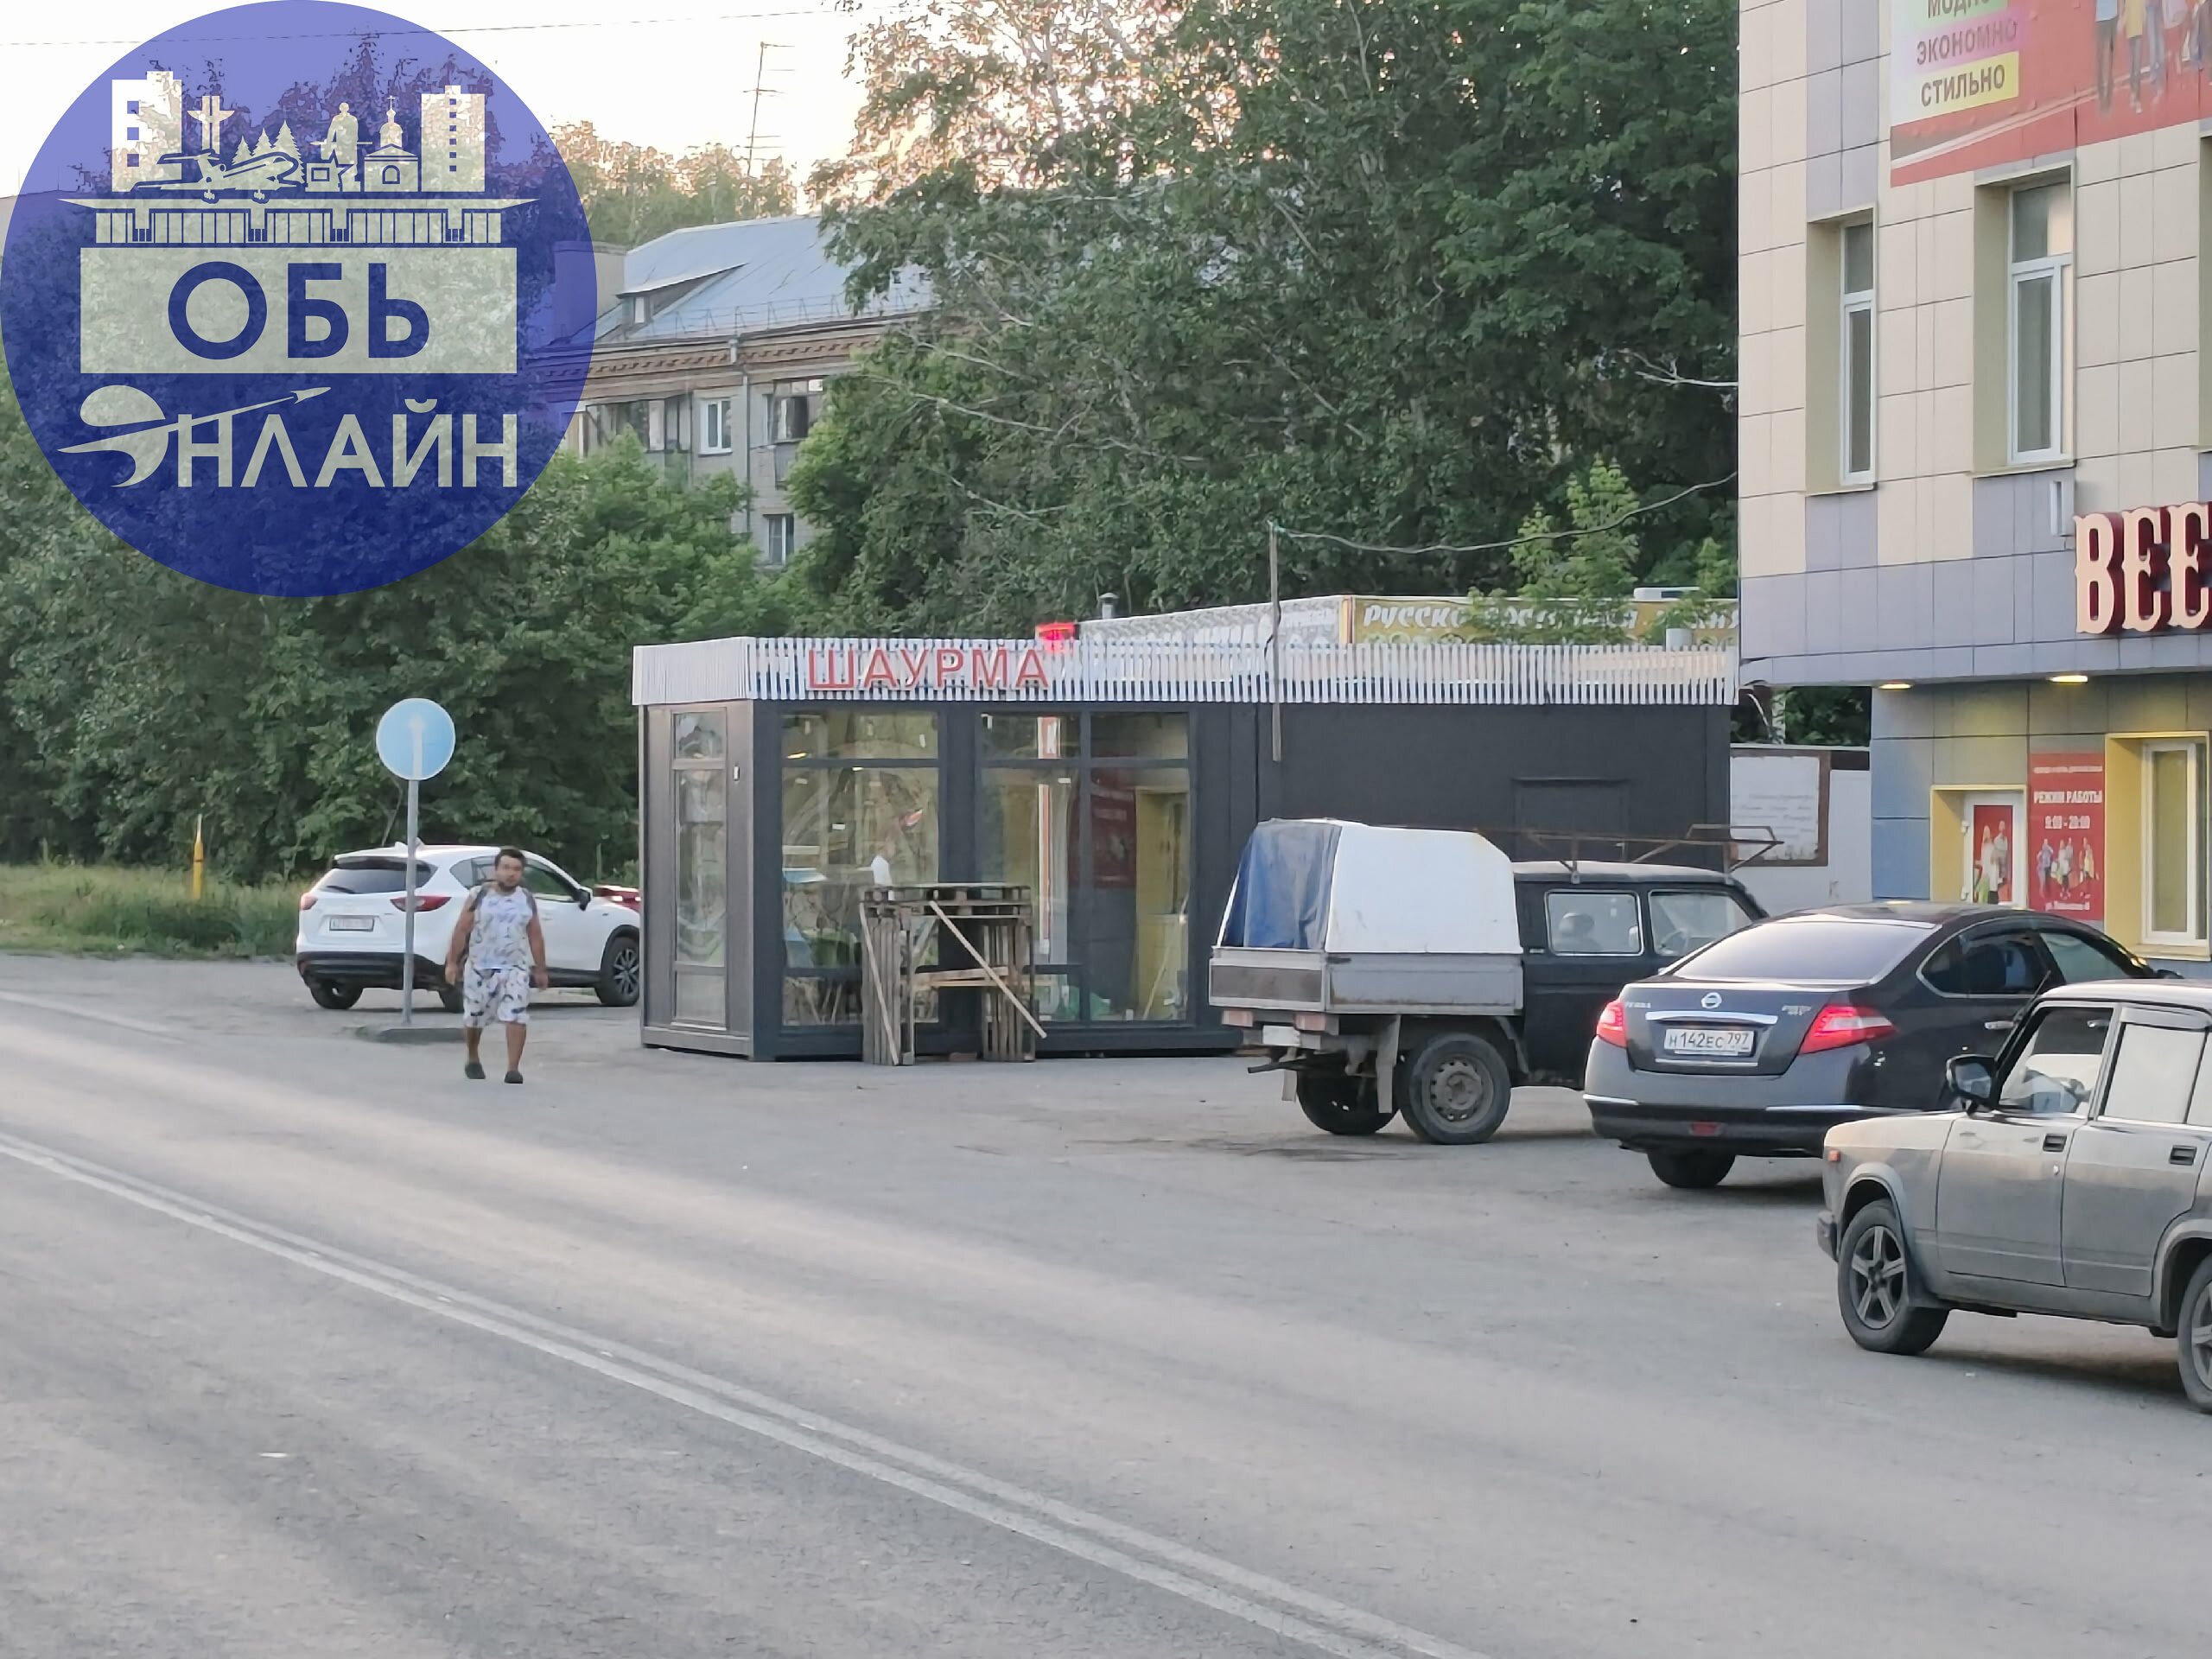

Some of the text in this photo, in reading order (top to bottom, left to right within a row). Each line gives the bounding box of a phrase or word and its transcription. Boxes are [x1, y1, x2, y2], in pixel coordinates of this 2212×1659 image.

[1928, 0, 1991, 18] МОД
[1916, 19, 2018, 65] ЭКОНОМНО
[1921, 64, 2005, 107] СТИЛЬНО
[807, 648, 1049, 690] ШАУРМА
